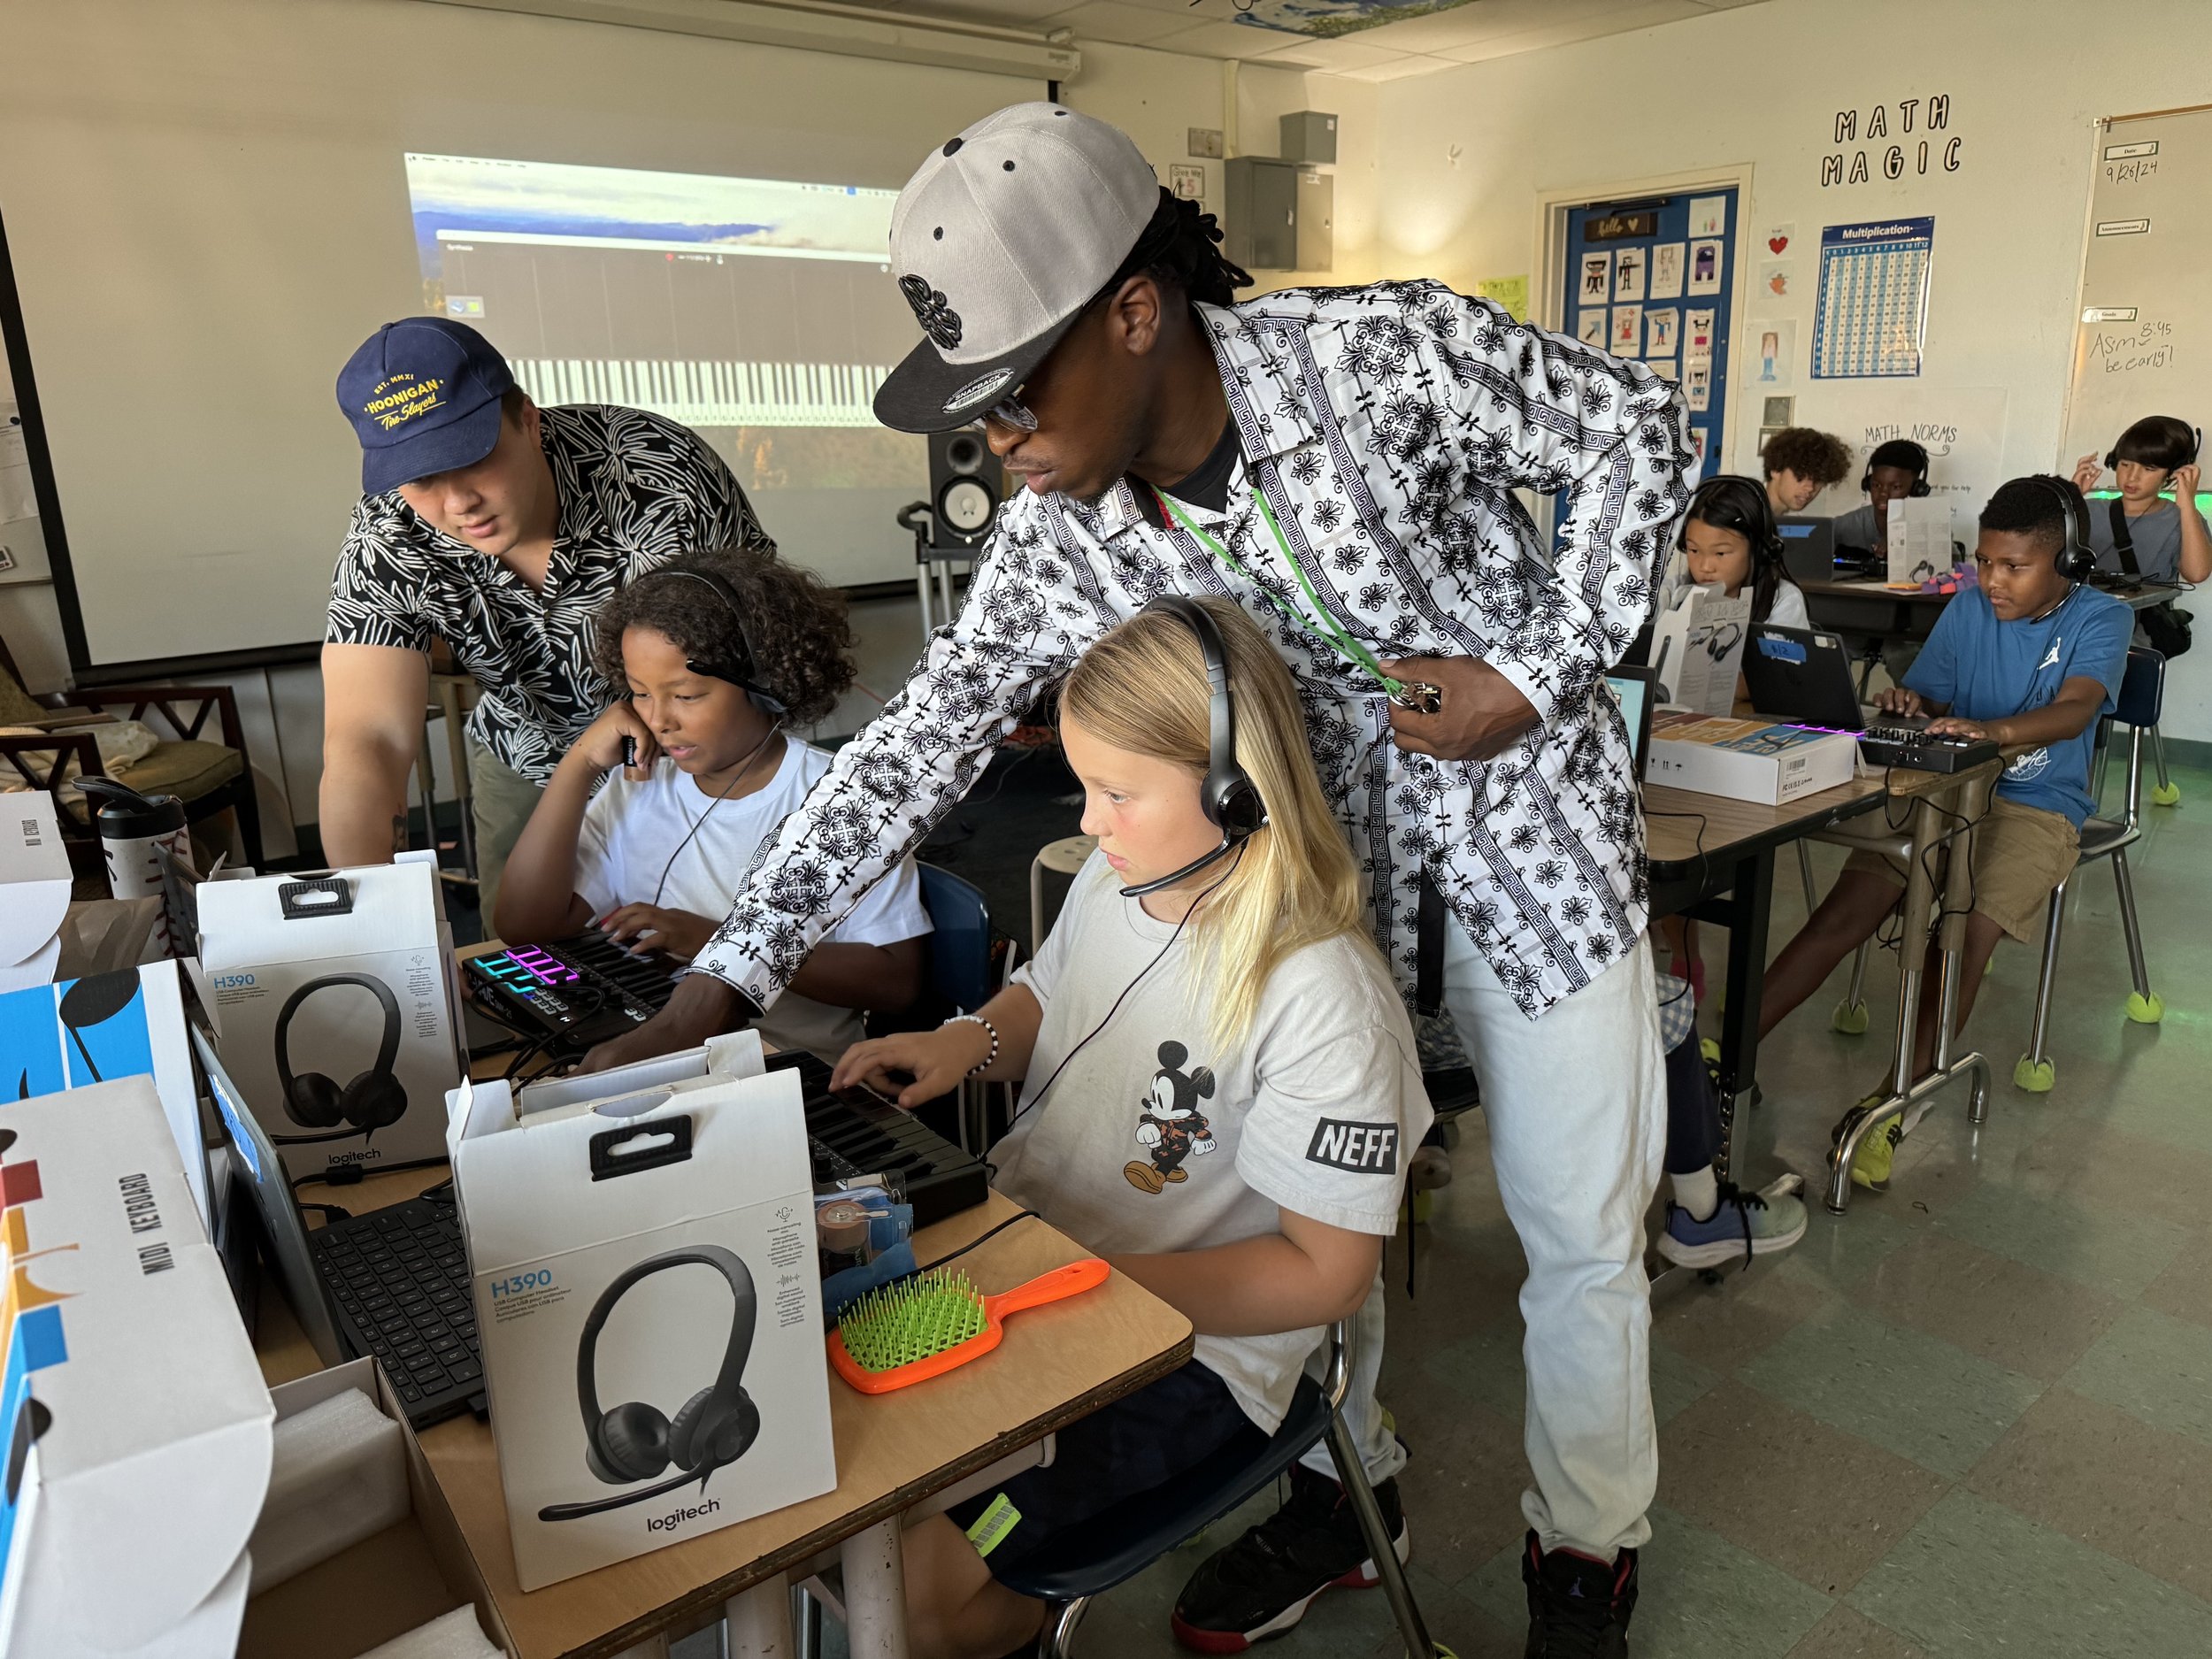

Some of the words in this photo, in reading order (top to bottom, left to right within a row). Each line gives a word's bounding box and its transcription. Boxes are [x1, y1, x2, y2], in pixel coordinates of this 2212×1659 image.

[1834, 94, 1949, 143] MATH
[1821, 136, 1962, 187] MAGIC
[1842, 224, 1910, 240] Multiplication
[2141, 321, 2171, 337] 8:45
[2106, 358, 2122, 373] be
[2125, 345, 2173, 370] early!
[367, 379, 439, 414] HOONIGAN
[374, 381, 389, 395] EST.
[390, 373, 414, 383] MMXI
[955, 373, 1001, 400] SNAPBACK
[380, 416, 400, 430] Tire
[400, 392, 437, 421] Slayers
[1865, 424, 1901, 442] MATH
[1911, 423, 1957, 442] NORMS
[214, 974, 255, 988] H390
[328, 1148, 380, 1166] logitech
[1316, 1124, 1395, 1168] NEFF
[119, 1173, 163, 1233] KEYBOARD
[136, 1241, 175, 1276] MIDI
[491, 1269, 552, 1298] H390
[506, 1292, 534, 1303] Computer
[647, 1499, 720, 1532] logitech
